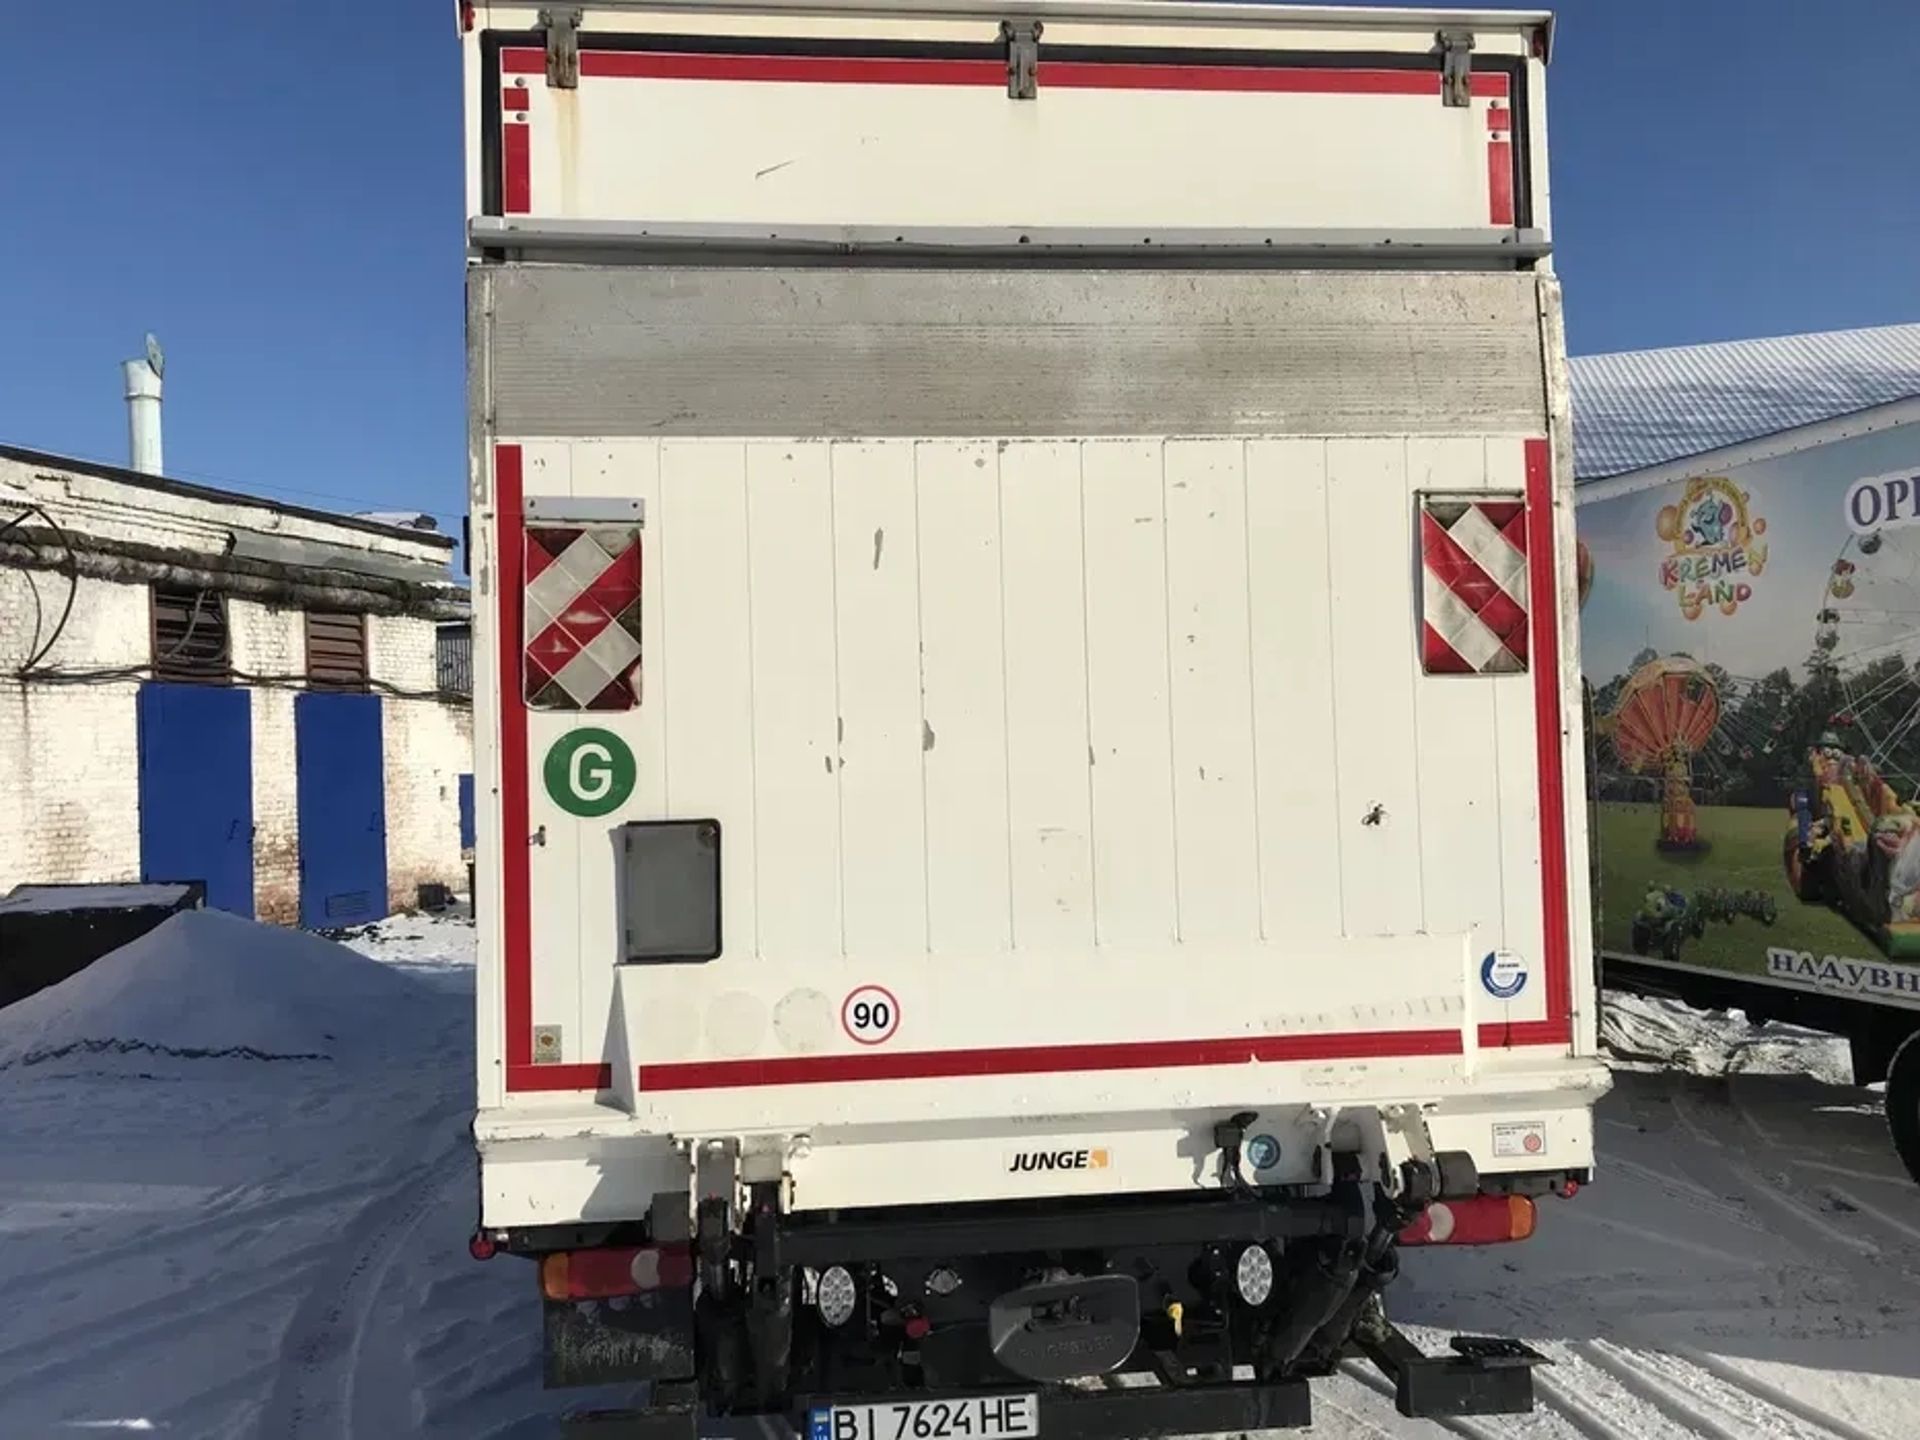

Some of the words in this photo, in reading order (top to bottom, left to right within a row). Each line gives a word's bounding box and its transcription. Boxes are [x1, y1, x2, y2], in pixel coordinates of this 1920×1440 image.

[1660, 543, 1768, 587] KREMEN
[1679, 580, 1752, 608] LAND
[569, 743, 613, 801] G
[853, 1002, 890, 1030] 90
[1009, 1150, 1089, 1172] JUNGE
[893, 1401, 970, 1440] 7624
[980, 1398, 1028, 1434] HE
